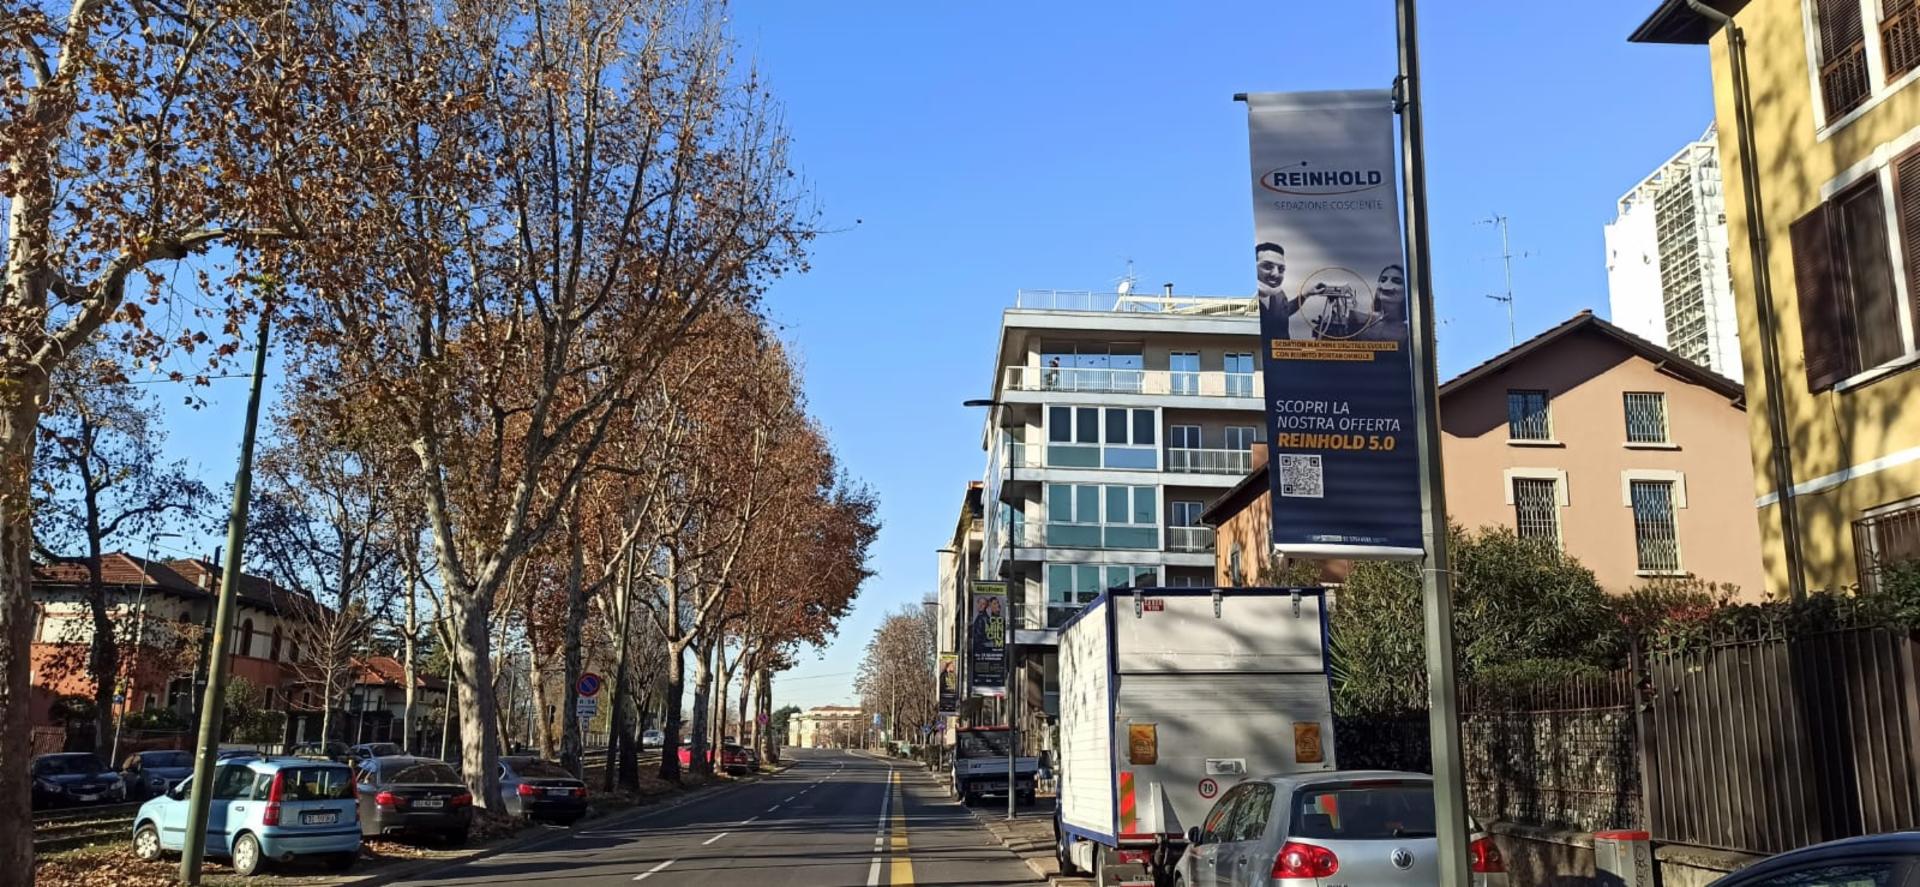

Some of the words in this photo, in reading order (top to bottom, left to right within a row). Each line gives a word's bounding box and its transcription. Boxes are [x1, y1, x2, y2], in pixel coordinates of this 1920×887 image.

[1273, 170, 1382, 187] REINHOLD
[1273, 200, 1328, 211] SEDAZIONE
[1330, 199, 1385, 210] COSCIENTE
[1275, 400, 1328, 414] SCOPRI
[1333, 401, 1350, 415] LA
[1277, 416, 1335, 430] NOSTRA
[1339, 417, 1401, 432] OFFERTA
[1278, 432, 1366, 450] REINHOLD
[1368, 435, 1395, 451] 5.0
[1203, 783, 1214, 793] 70
